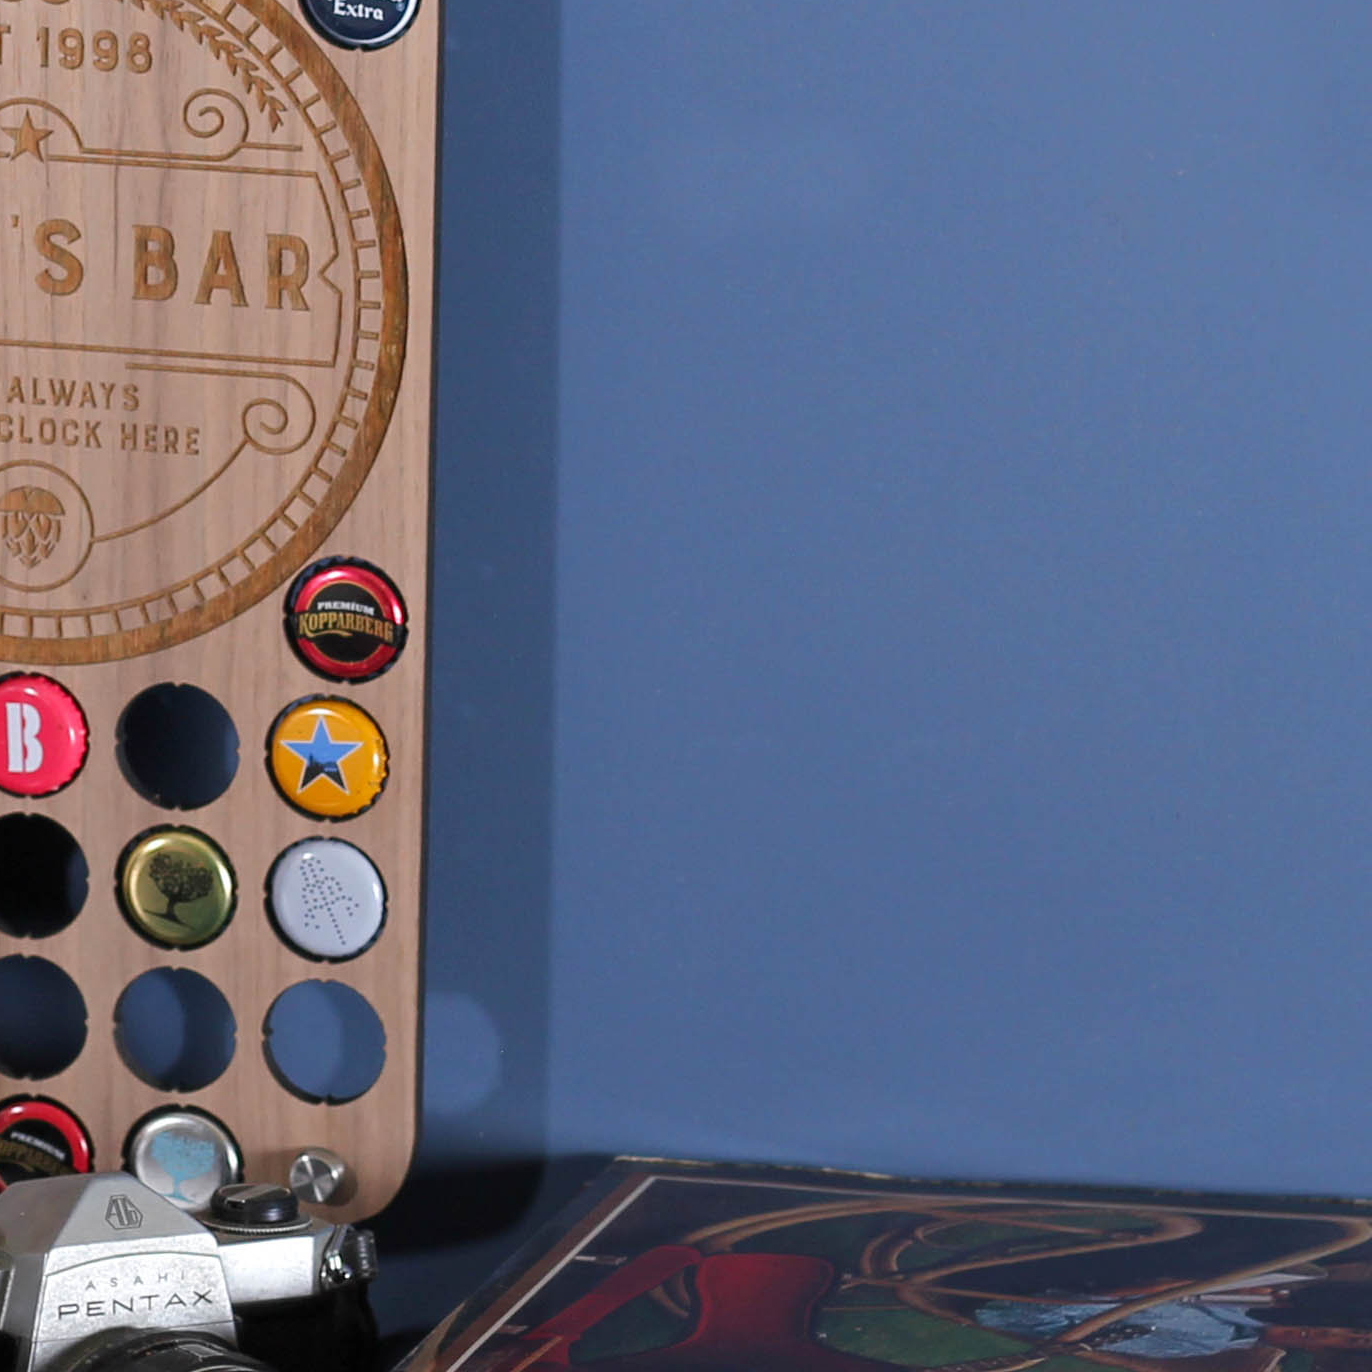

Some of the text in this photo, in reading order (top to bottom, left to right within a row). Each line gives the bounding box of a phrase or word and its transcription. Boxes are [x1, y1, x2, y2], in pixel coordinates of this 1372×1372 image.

[36, 26, 153, 74] 1998
[131, 223, 312, 312] BAR
[6, 375, 141, 413] ALWAYS
[119, 422, 202, 456] HERE
[317, 600, 376, 617] PREMIUM
[299, 612, 394, 644] KOPPARBERG
[5, 701, 44, 773] B
[85, 1270, 185, 1291] ASAHI
[58, 1289, 213, 1320] PENTAX
